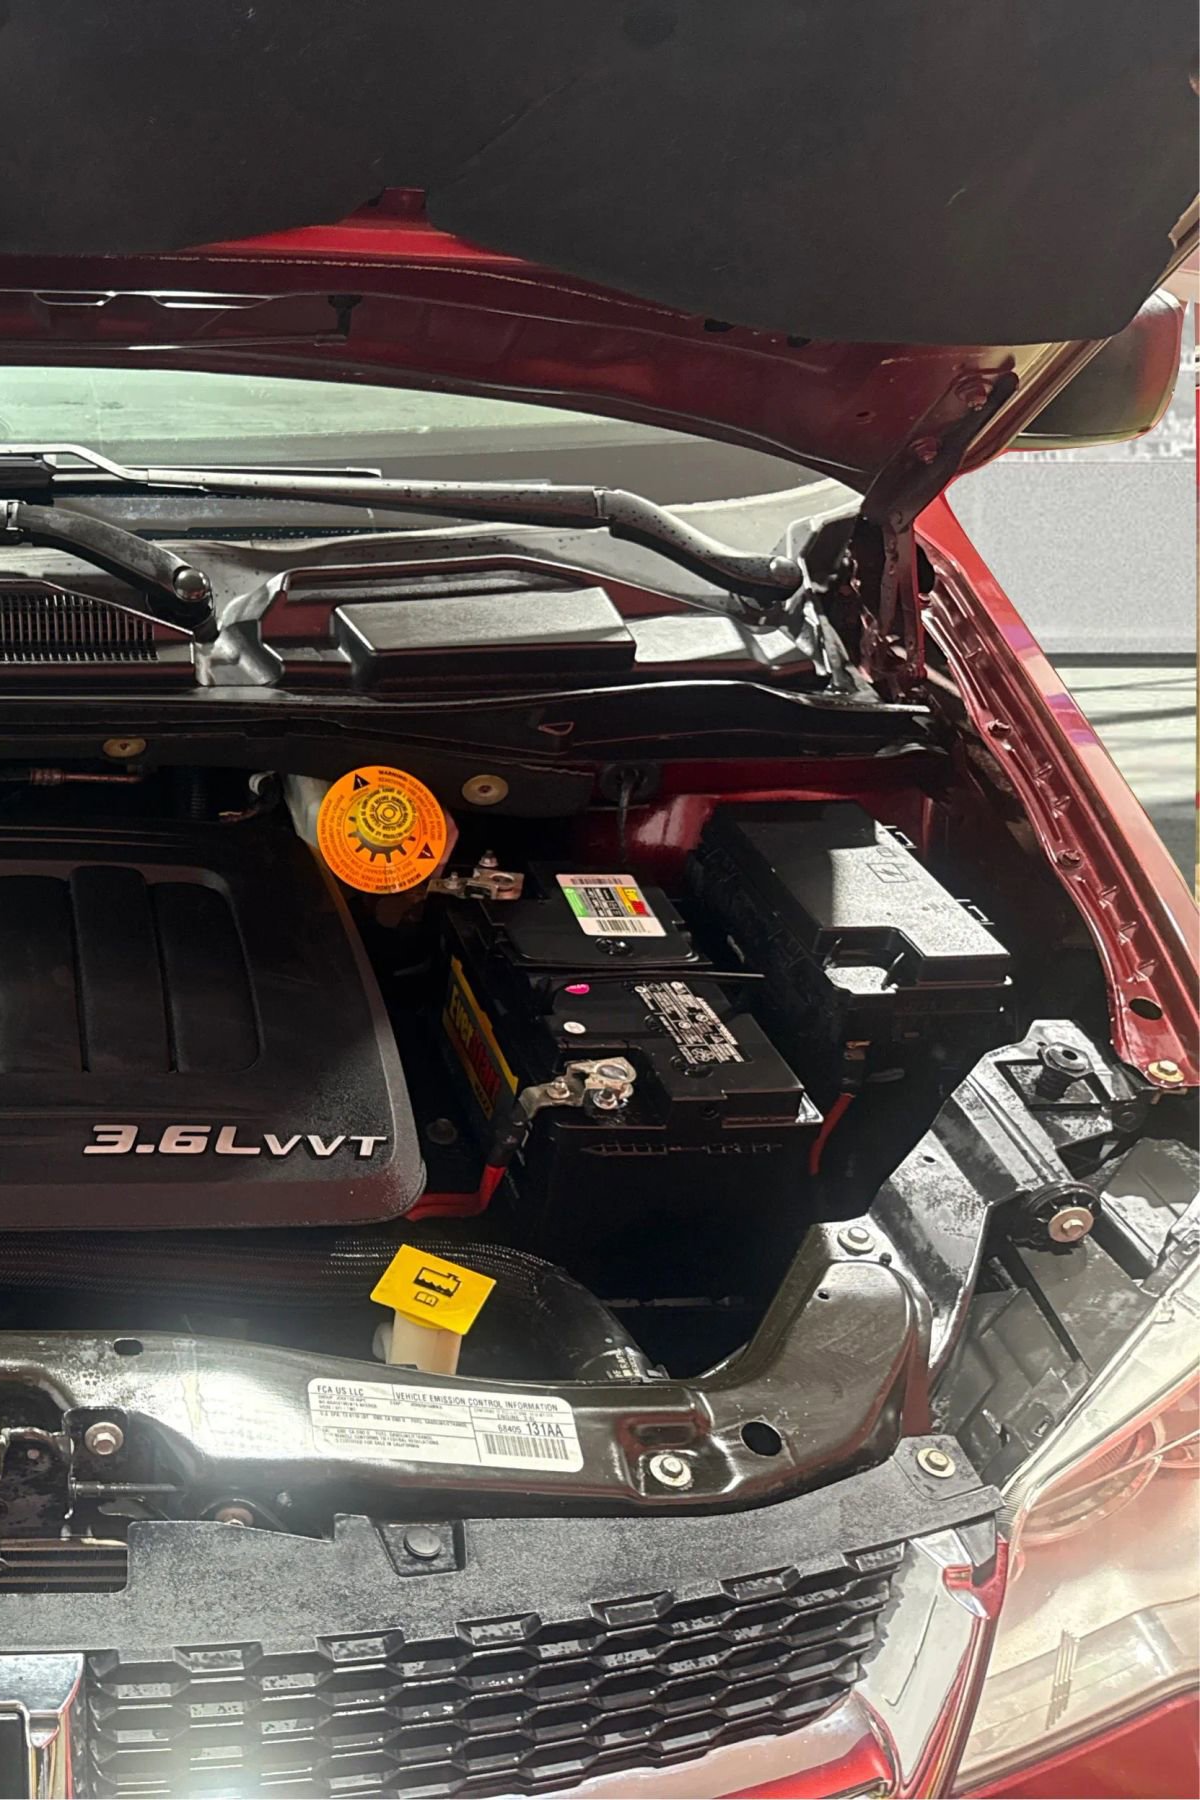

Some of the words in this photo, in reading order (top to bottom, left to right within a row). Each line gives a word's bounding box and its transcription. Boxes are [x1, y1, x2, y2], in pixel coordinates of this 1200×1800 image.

[83, 1125, 261, 1154] 3.6L
[263, 1134, 387, 1156] VVT
[317, 1385, 333, 1394] FCA
[335, 1386, 347, 1395] US
[349, 1387, 364, 1397] LLC
[395, 1392, 426, 1402] VEHICLE
[429, 1394, 466, 1406] EMISSION
[468, 1398, 503, 1408] CONTROL
[504, 1401, 558, 1411] INFORMATION
[526, 1421, 565, 1438] 131AA
